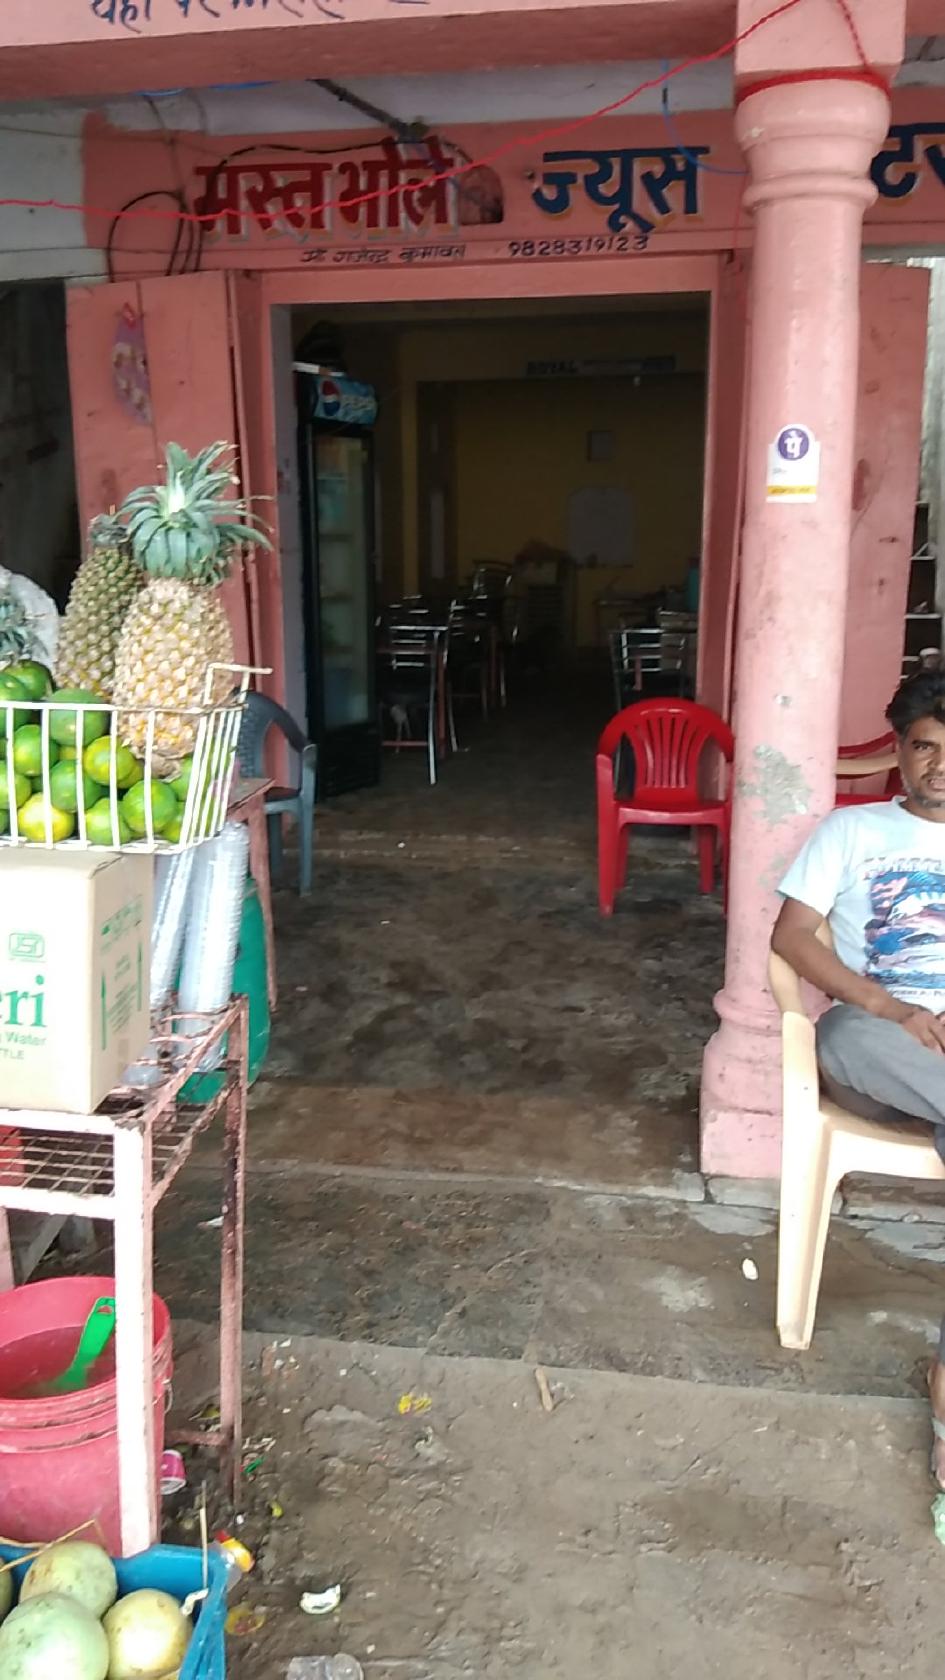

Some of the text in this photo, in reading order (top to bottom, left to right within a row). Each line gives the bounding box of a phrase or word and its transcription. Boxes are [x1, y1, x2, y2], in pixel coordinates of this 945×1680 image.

[193, 163, 333, 234] मस्त
[532, 146, 711, 233] ज्यूस
[509, 236, 649, 257] 9828319123
[0, 974, 48, 1028] ri
[5, 1032, 47, 1046] Water
